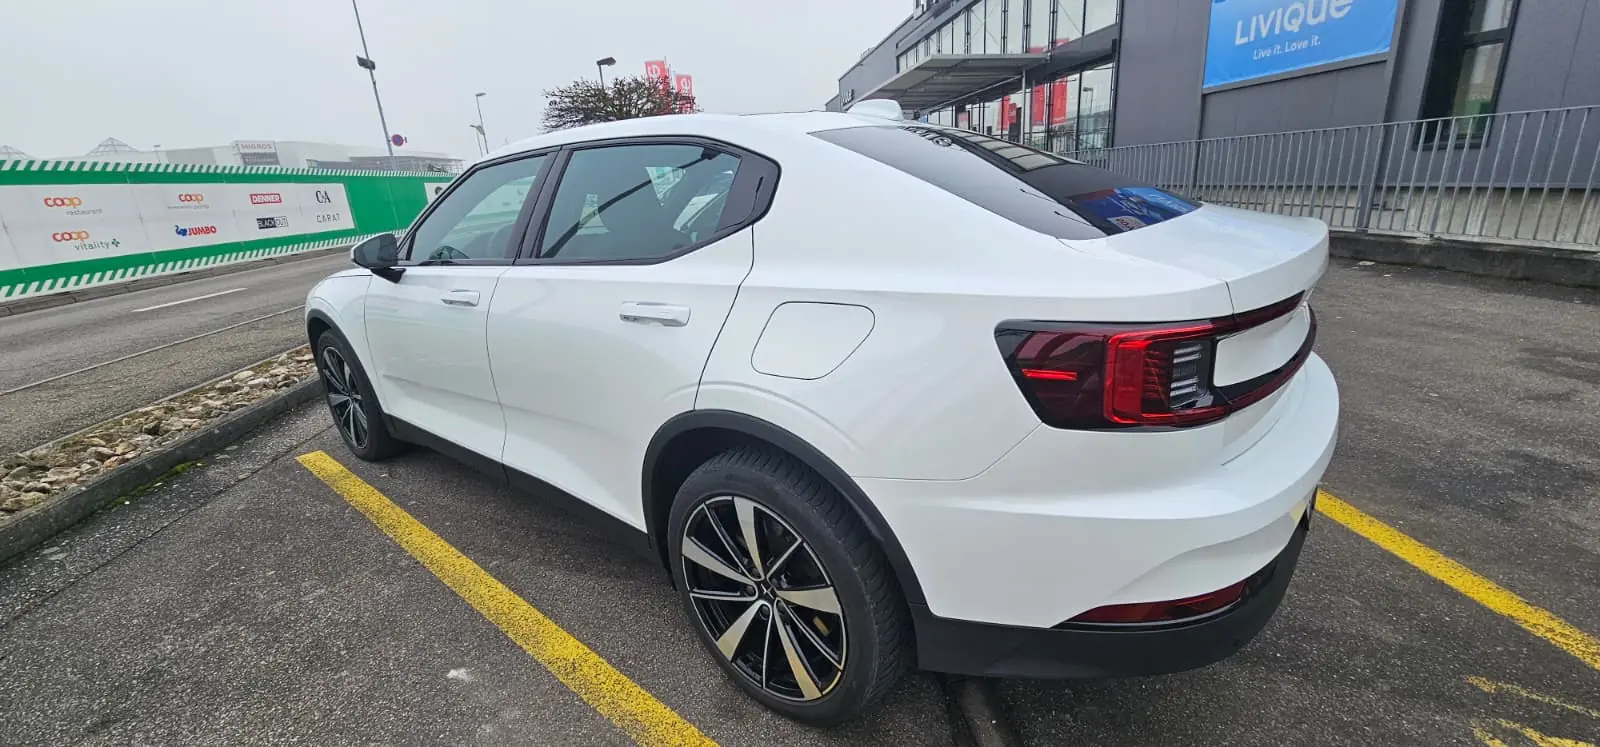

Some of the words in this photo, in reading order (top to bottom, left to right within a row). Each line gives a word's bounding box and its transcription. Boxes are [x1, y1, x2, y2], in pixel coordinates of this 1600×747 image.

[1252, 48, 1272, 60] Live
[1273, 44, 1282, 54] it.
[1285, 39, 1309, 53] Love
[1311, 35, 1321, 47] it.
[44, 196, 82, 208] coop
[178, 193, 205, 205] coop
[252, 194, 281, 204] DENNER
[316, 213, 341, 223] CARAT
[188, 225, 217, 236] JUMBO
[52, 230, 90, 243] coop
[73, 240, 110, 251] vitality
